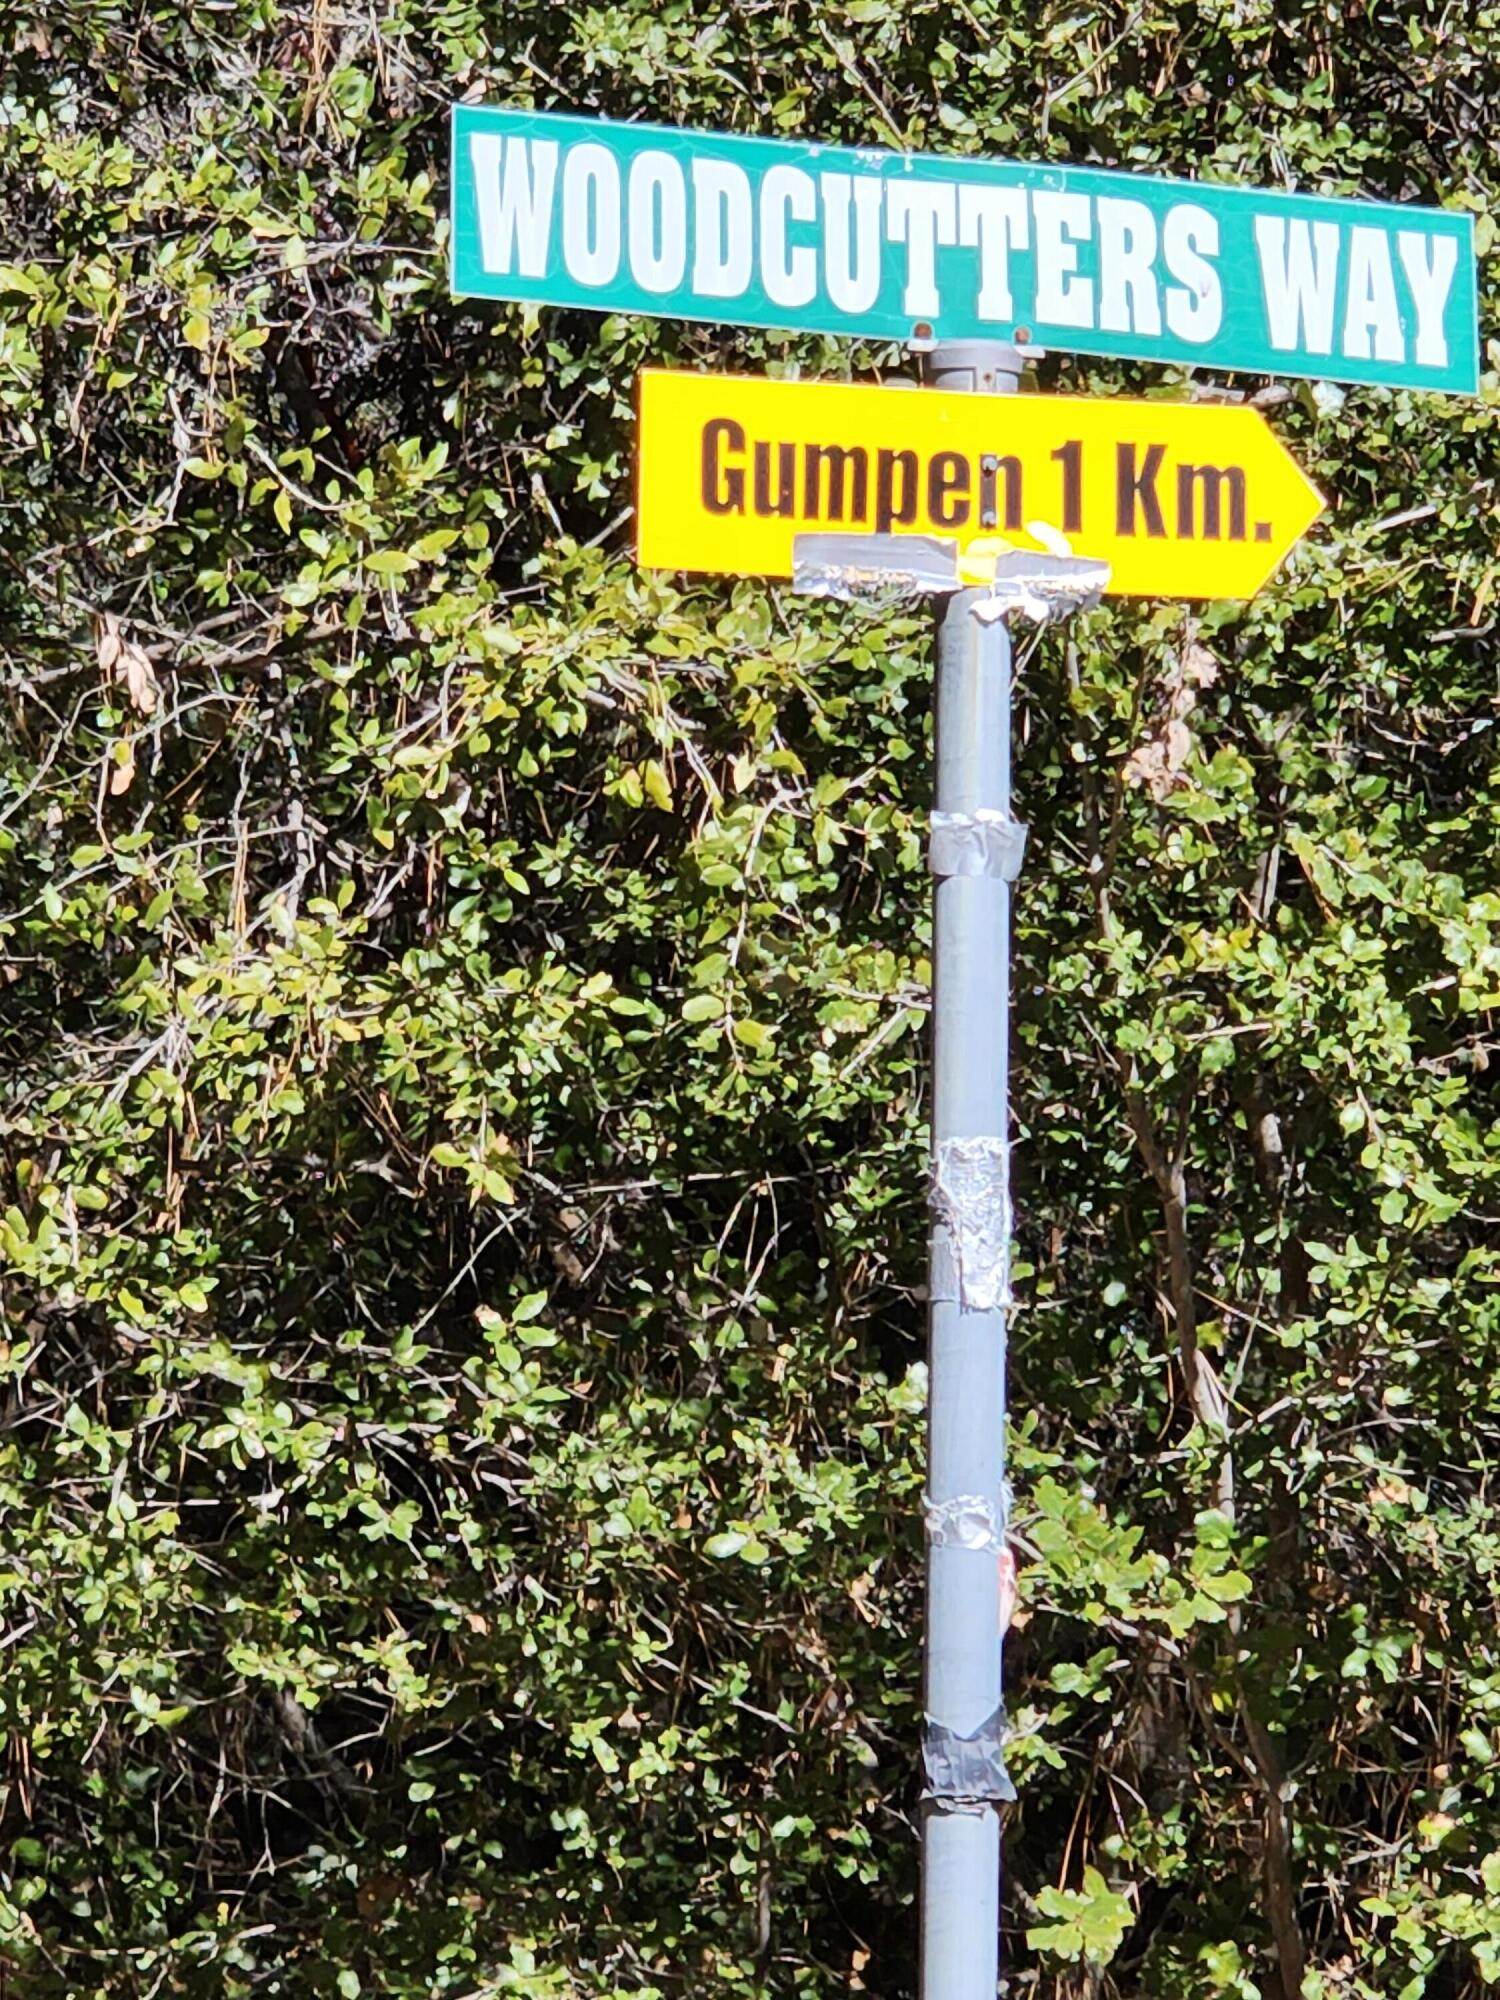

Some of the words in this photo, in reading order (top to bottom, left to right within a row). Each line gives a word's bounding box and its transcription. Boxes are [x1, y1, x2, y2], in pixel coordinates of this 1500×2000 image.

[470, 132, 1222, 344] WOODCUTTERS
[1254, 215, 1458, 367] WAY
[701, 417, 1022, 534] Gumpen
[1050, 440, 1082, 533] 1
[1116, 442, 1272, 543] Km.
